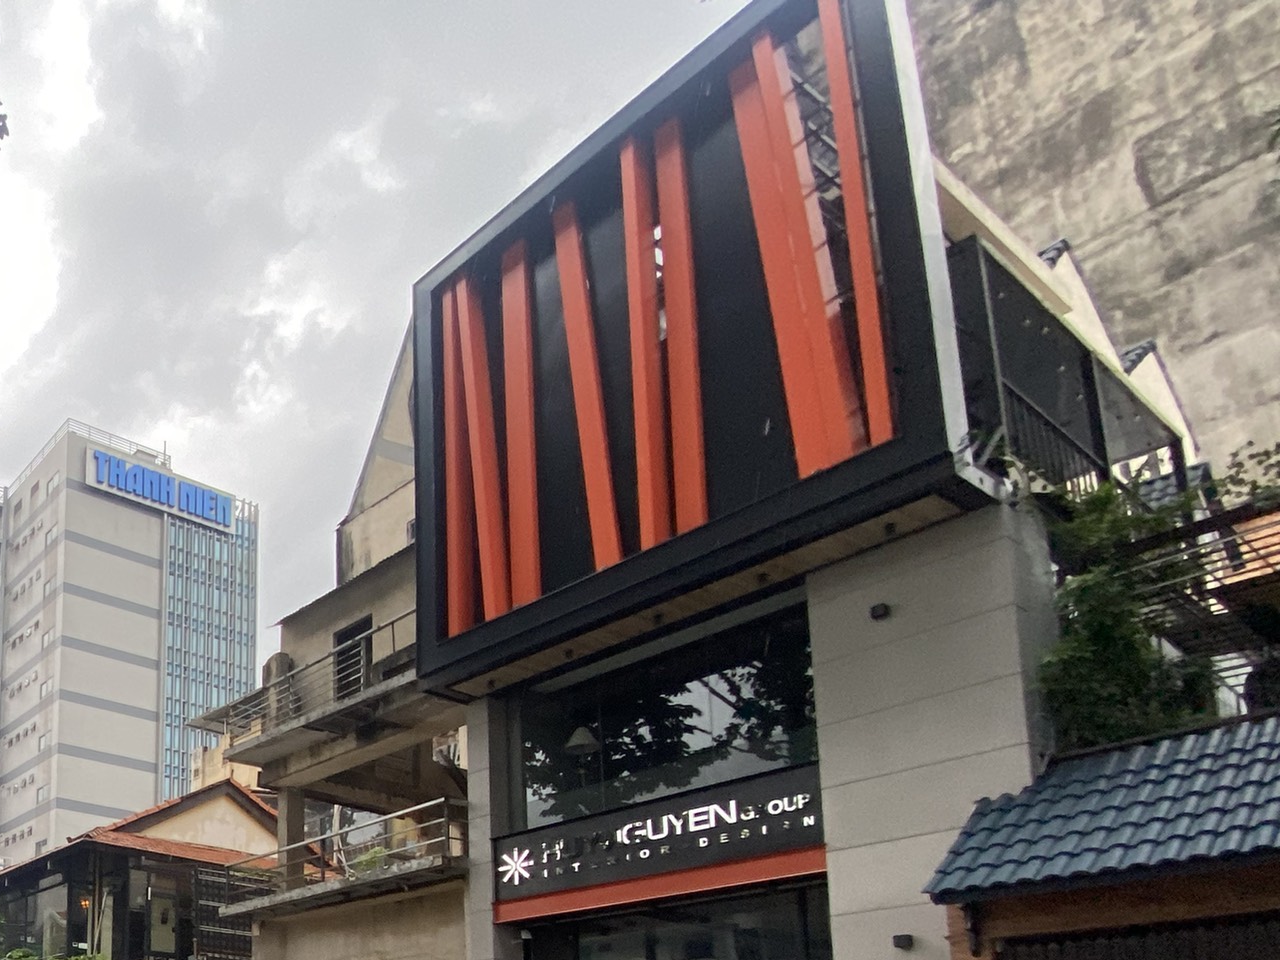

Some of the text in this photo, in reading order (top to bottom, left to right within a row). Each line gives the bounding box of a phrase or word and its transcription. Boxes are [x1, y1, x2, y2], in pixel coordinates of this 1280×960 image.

[94, 449, 176, 508] THANH
[740, 793, 811, 821] GOUP
[541, 845, 671, 878] INTIOR
